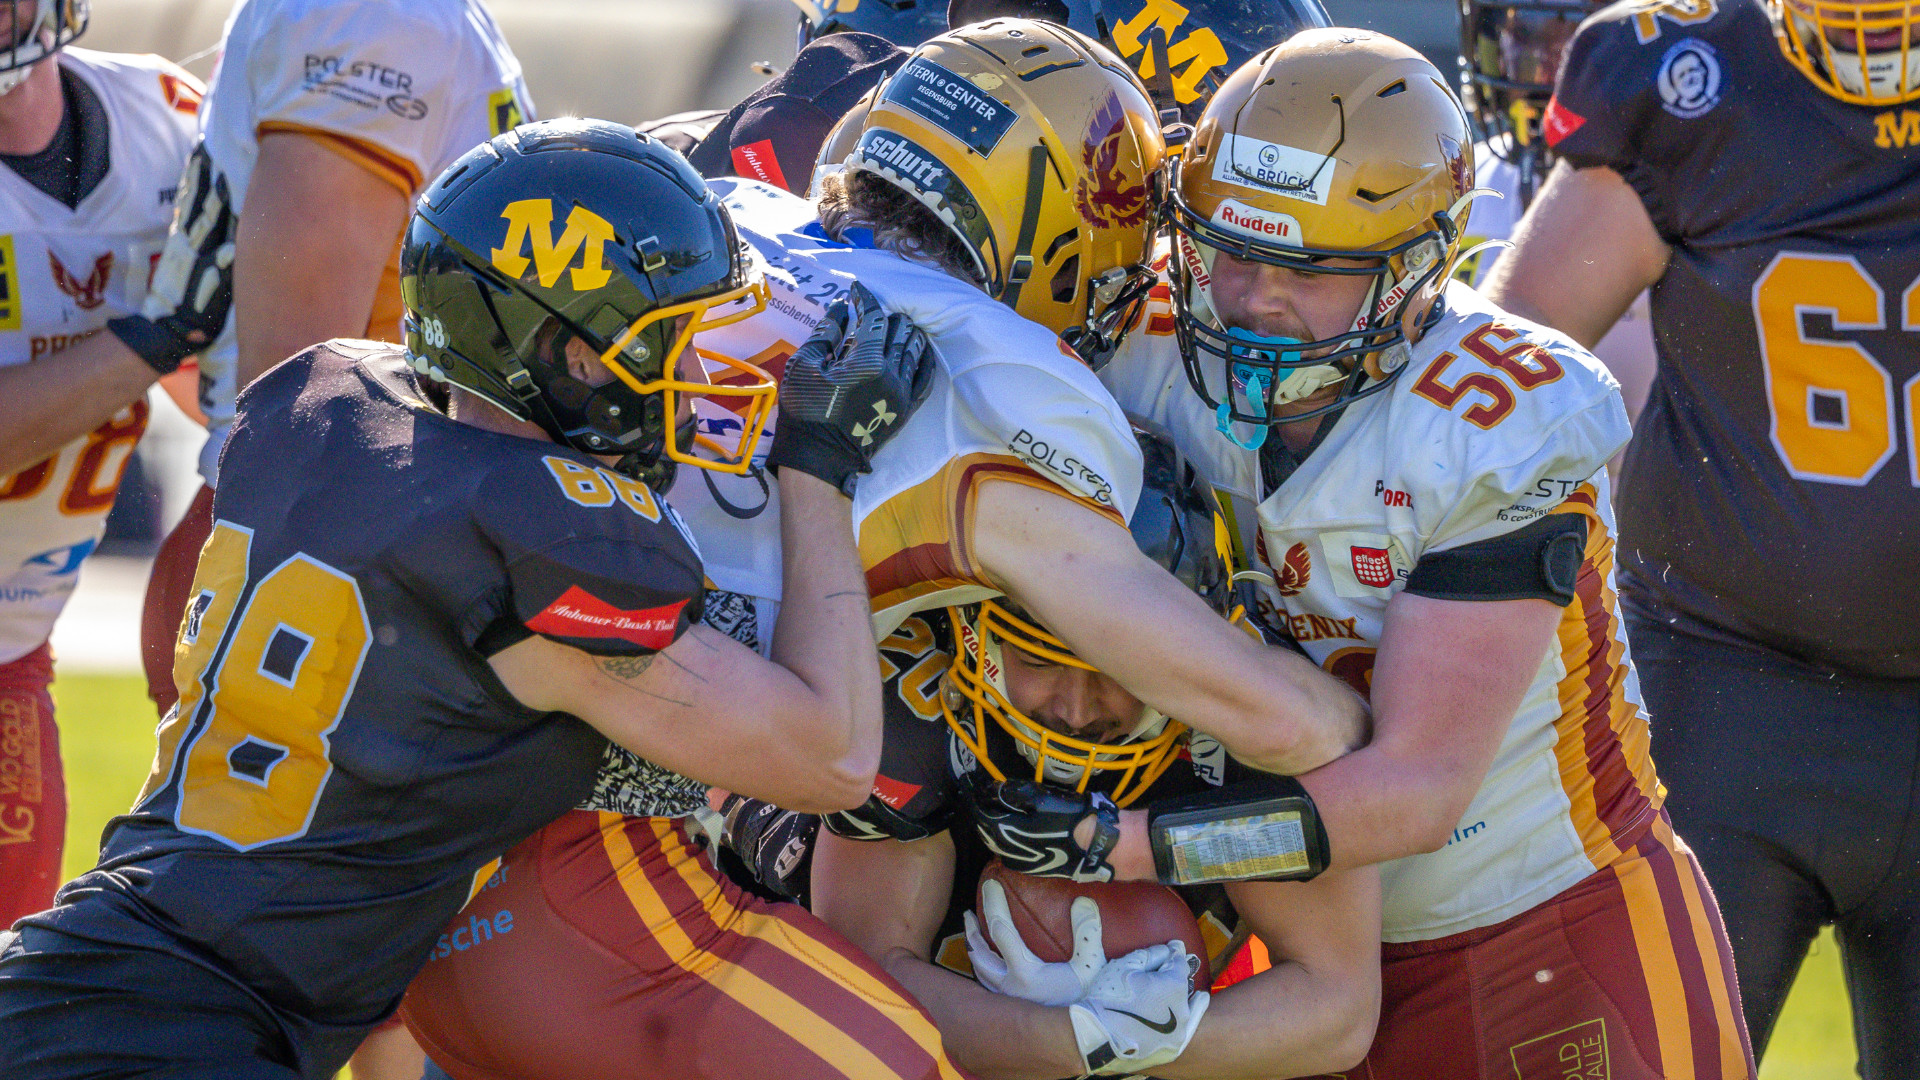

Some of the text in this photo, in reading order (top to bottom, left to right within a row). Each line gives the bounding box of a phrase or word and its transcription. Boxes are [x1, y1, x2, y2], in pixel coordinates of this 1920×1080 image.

[303, 53, 413, 96] POLSTER
[1111, 0, 1229, 105] M
[905, 63, 997, 121] STERN CENTER
[917, 84, 958, 112] REGENSBURG
[865, 135, 944, 187] schutt
[491, 198, 615, 291] M
[1221, 206, 1289, 237] Riddell
[423, 316, 446, 349] 88
[1410, 321, 1566, 431] 56
[1752, 250, 1920, 488] 6
[541, 455, 662, 524] 88
[1355, 554, 1387, 565] effect
[548, 605, 652, 631] Anheuser-Busch
[129, 518, 374, 853] 88
